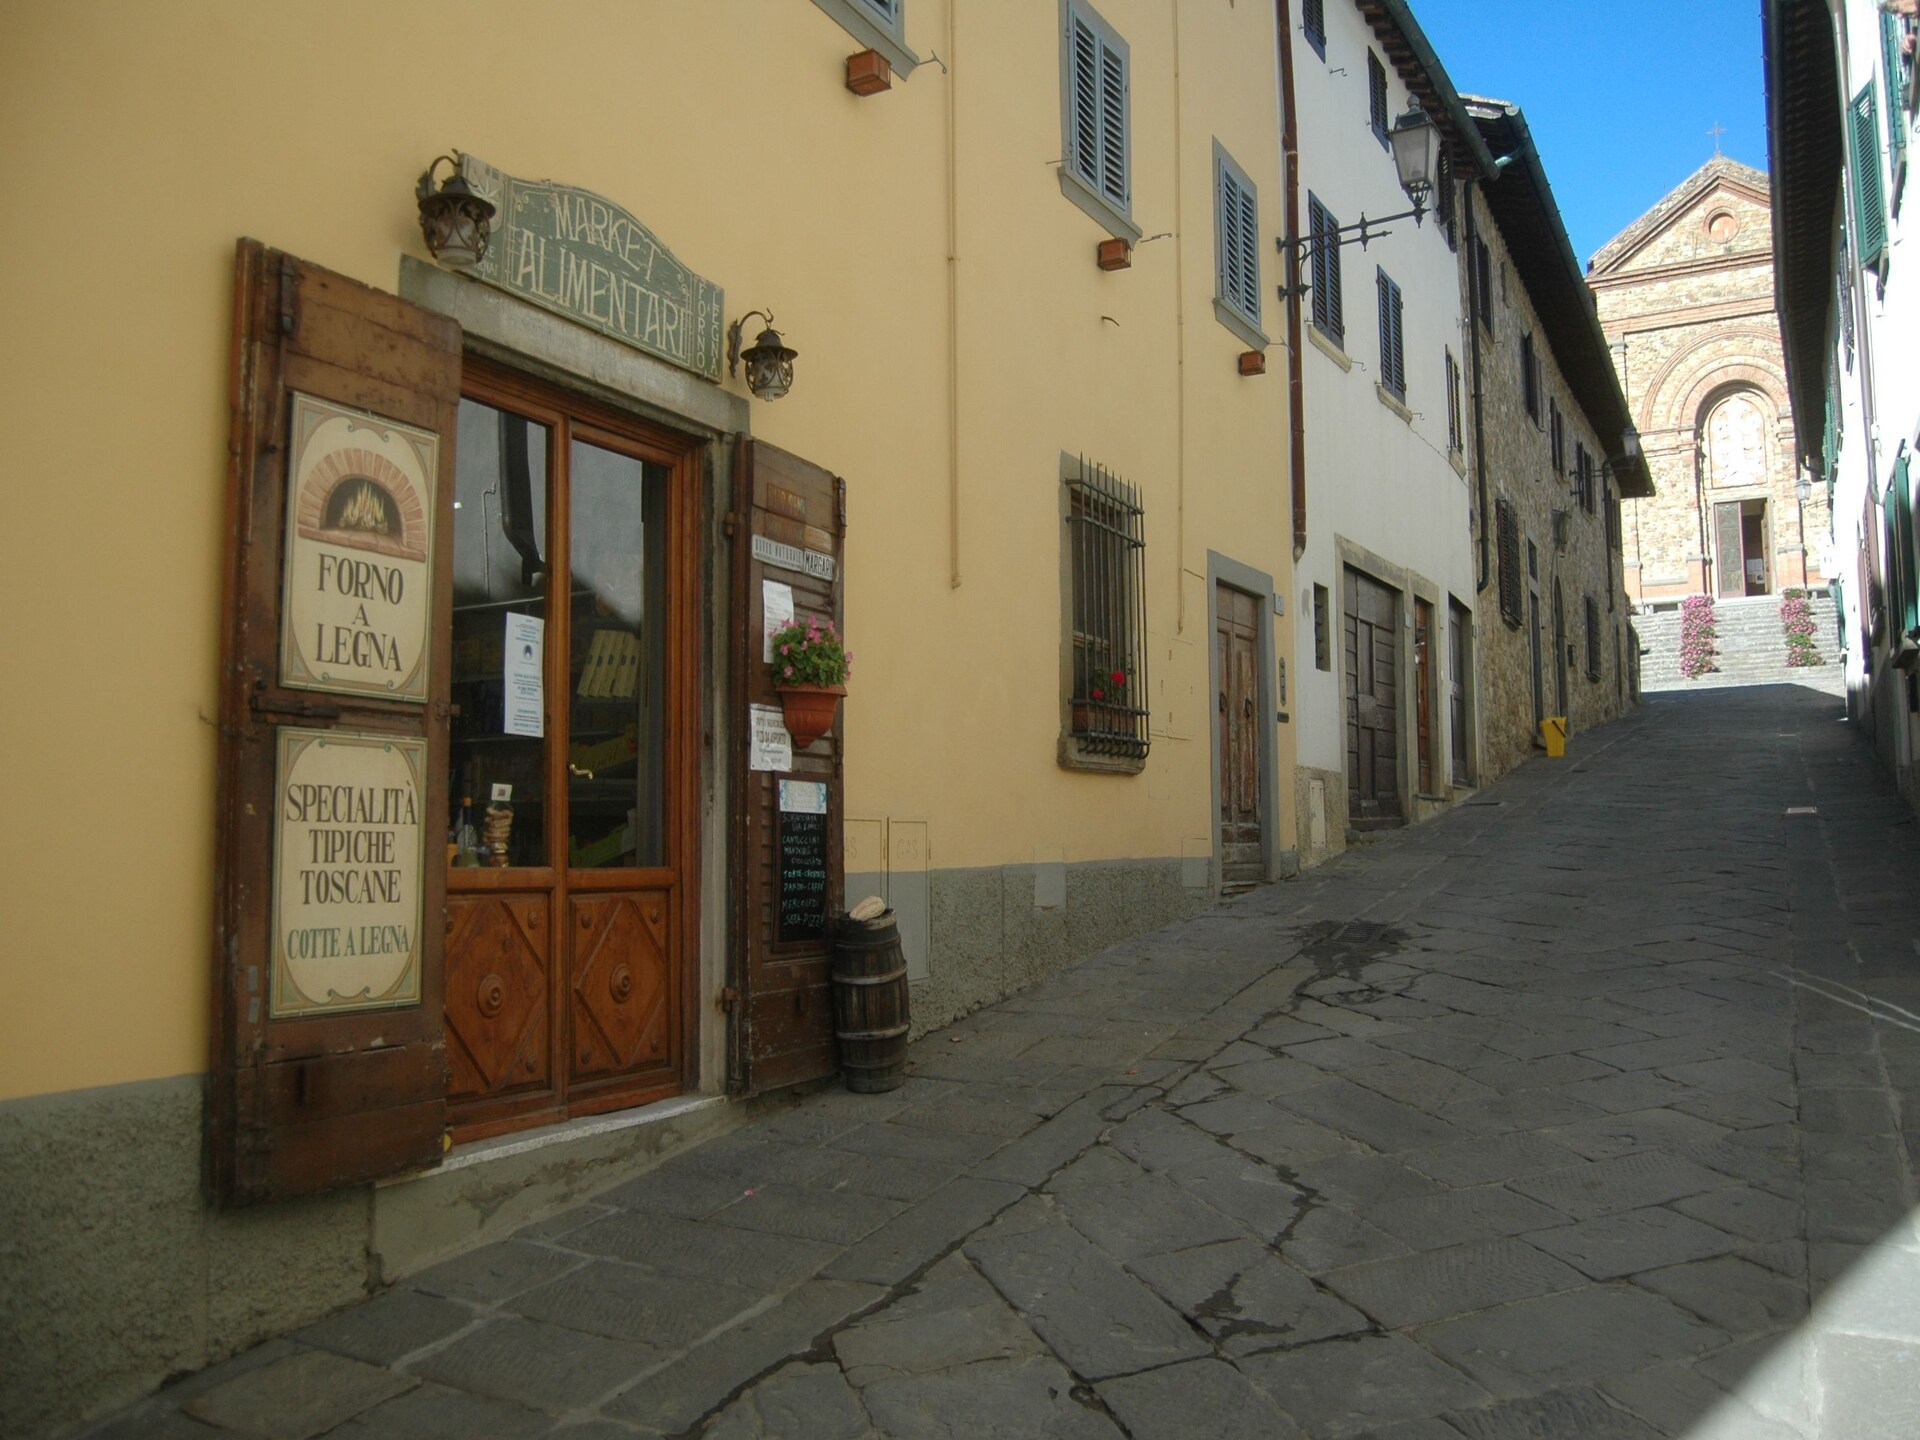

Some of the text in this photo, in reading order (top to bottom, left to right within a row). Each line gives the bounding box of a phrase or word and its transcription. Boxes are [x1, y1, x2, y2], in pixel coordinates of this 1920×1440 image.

[554, 194, 666, 282] MARKET
[516, 228, 687, 359] ALIMENTARI
[697, 282, 706, 369] FORNO
[710, 289, 719, 376] LEGNA
[317, 553, 404, 605] FORNO
[805, 553, 834, 579] MARGARI
[352, 603, 371, 627] A
[316, 623, 402, 672] LEGNA
[286, 780, 418, 825] SPECIALITÀ
[309, 829, 395, 864] TIPICHE
[300, 870, 401, 905] TOSCANE
[287, 925, 410, 960] COTTE A LEGNA
